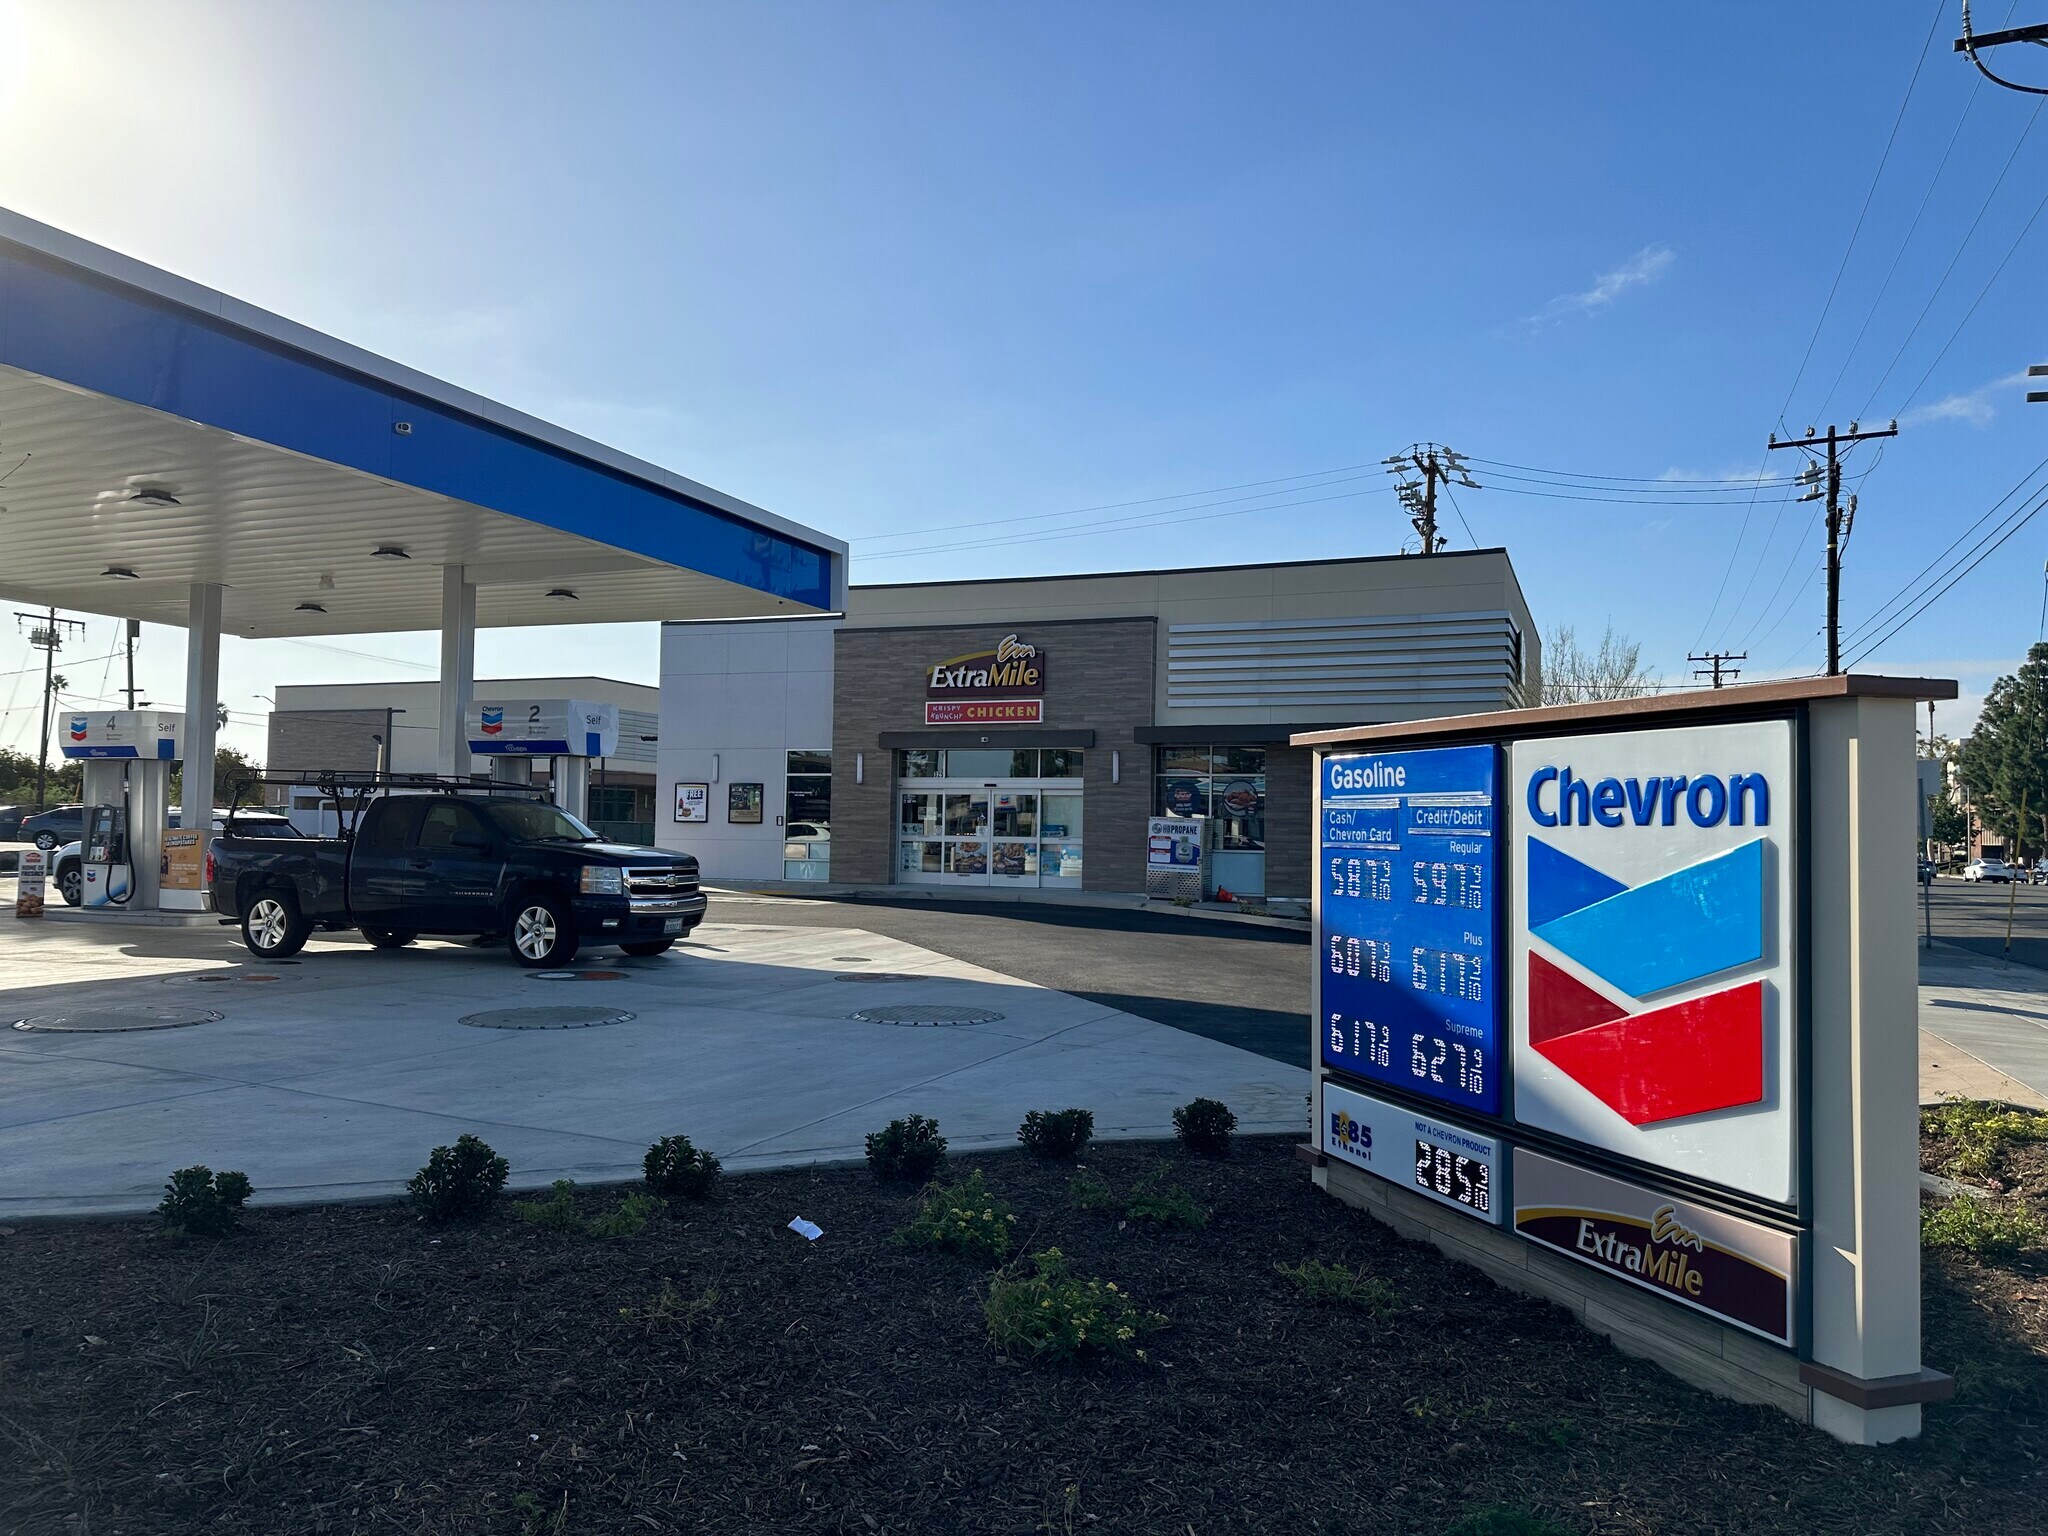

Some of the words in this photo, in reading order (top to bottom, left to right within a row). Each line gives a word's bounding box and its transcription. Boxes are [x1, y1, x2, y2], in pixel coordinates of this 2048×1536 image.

[930, 661, 1039, 688] ExtraMile
[528, 705, 541, 723] 2
[586, 715, 601, 725] Self
[930, 712, 963, 720] KRUNCHY
[967, 706, 1037, 718] CHICKEN
[106, 715, 116, 731] 4
[158, 723, 176, 732] Self
[1331, 761, 1406, 789] Gasoline
[686, 789, 704, 800] FREE
[1527, 765, 1769, 827] Chevron
[1330, 811, 1357, 825] Cash/
[1416, 809, 1483, 825] Credit/Debit
[1330, 828, 1367, 842] Chevron
[1370, 828, 1392, 842] Card
[1450, 841, 1483, 856] Regular
[1463, 932, 1483, 946] Plus
[1445, 1019, 1484, 1039] Supreme
[1415, 1121, 1427, 1134] NOT
[1427, 1125, 1432, 1135] A
[1433, 1127, 1462, 1147] CHEVRON
[1462, 1138, 1491, 1157] PRODUCT
[1331, 1137, 1372, 1161] Ethanol
[1576, 1218, 1703, 1296] ExtraMile
